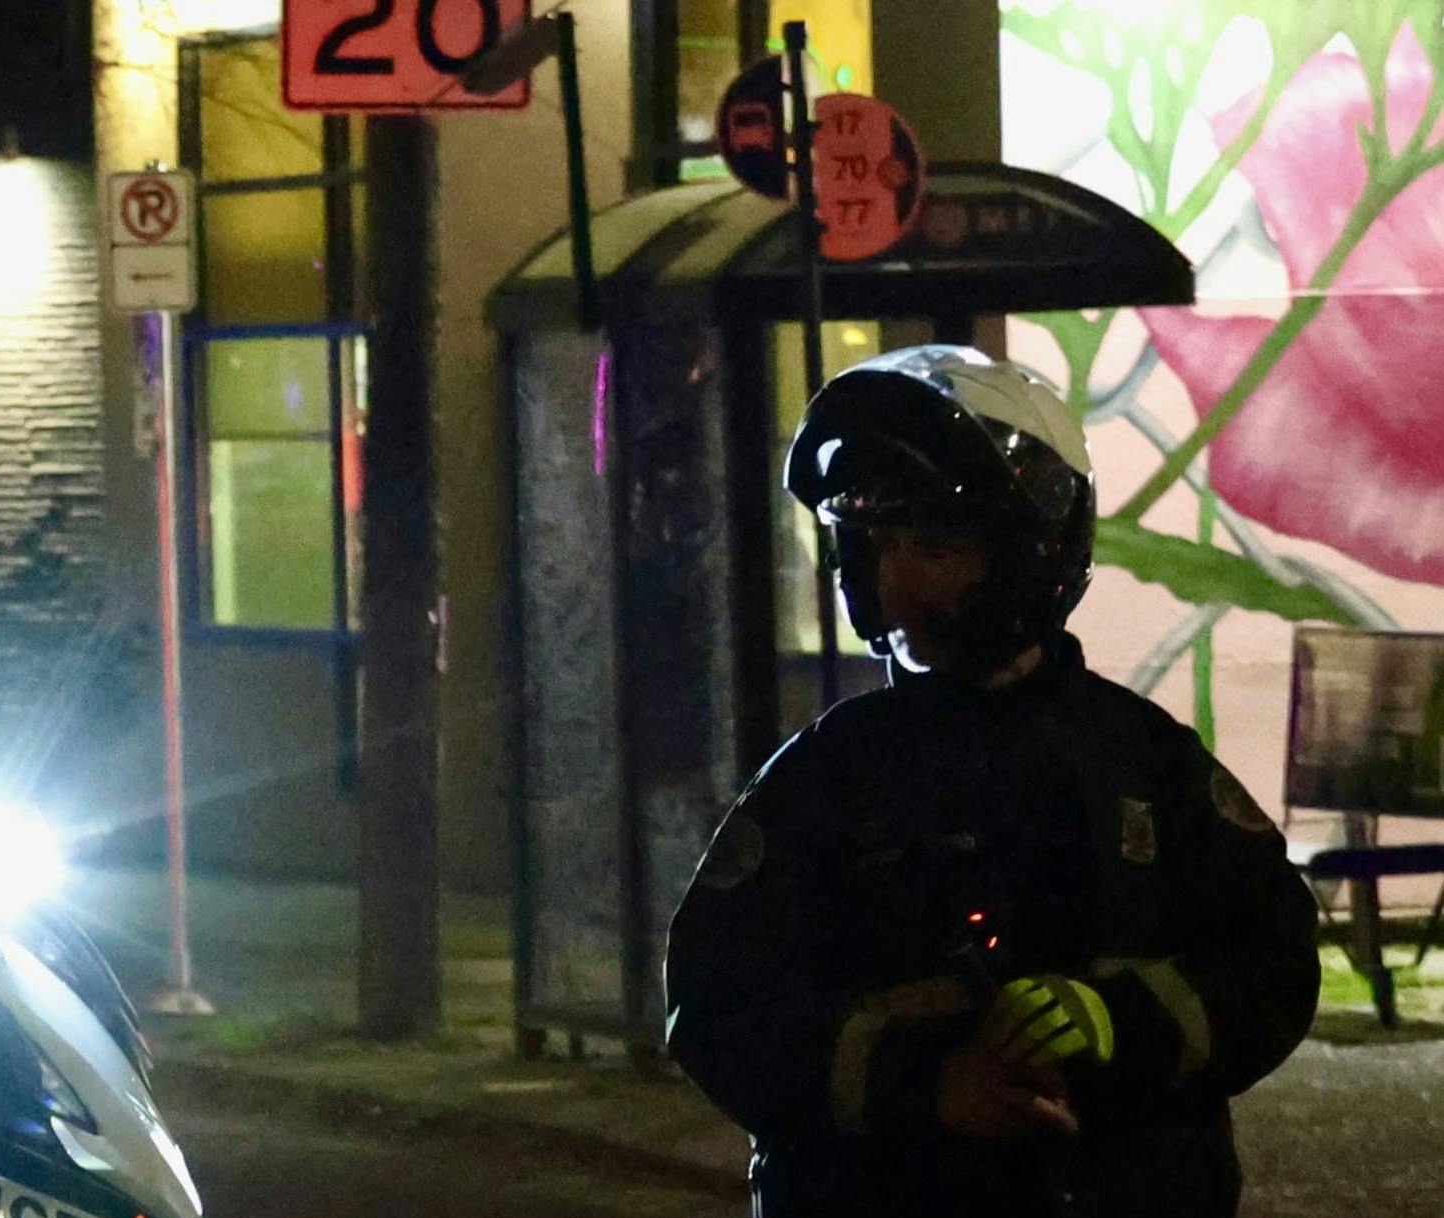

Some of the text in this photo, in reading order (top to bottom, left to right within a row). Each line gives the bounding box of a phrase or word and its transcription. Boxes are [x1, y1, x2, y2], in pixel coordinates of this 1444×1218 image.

[315, 0, 499, 75] 20
[831, 110, 861, 135] 17
[832, 156, 868, 180] 70
[837, 199, 873, 225] 77
